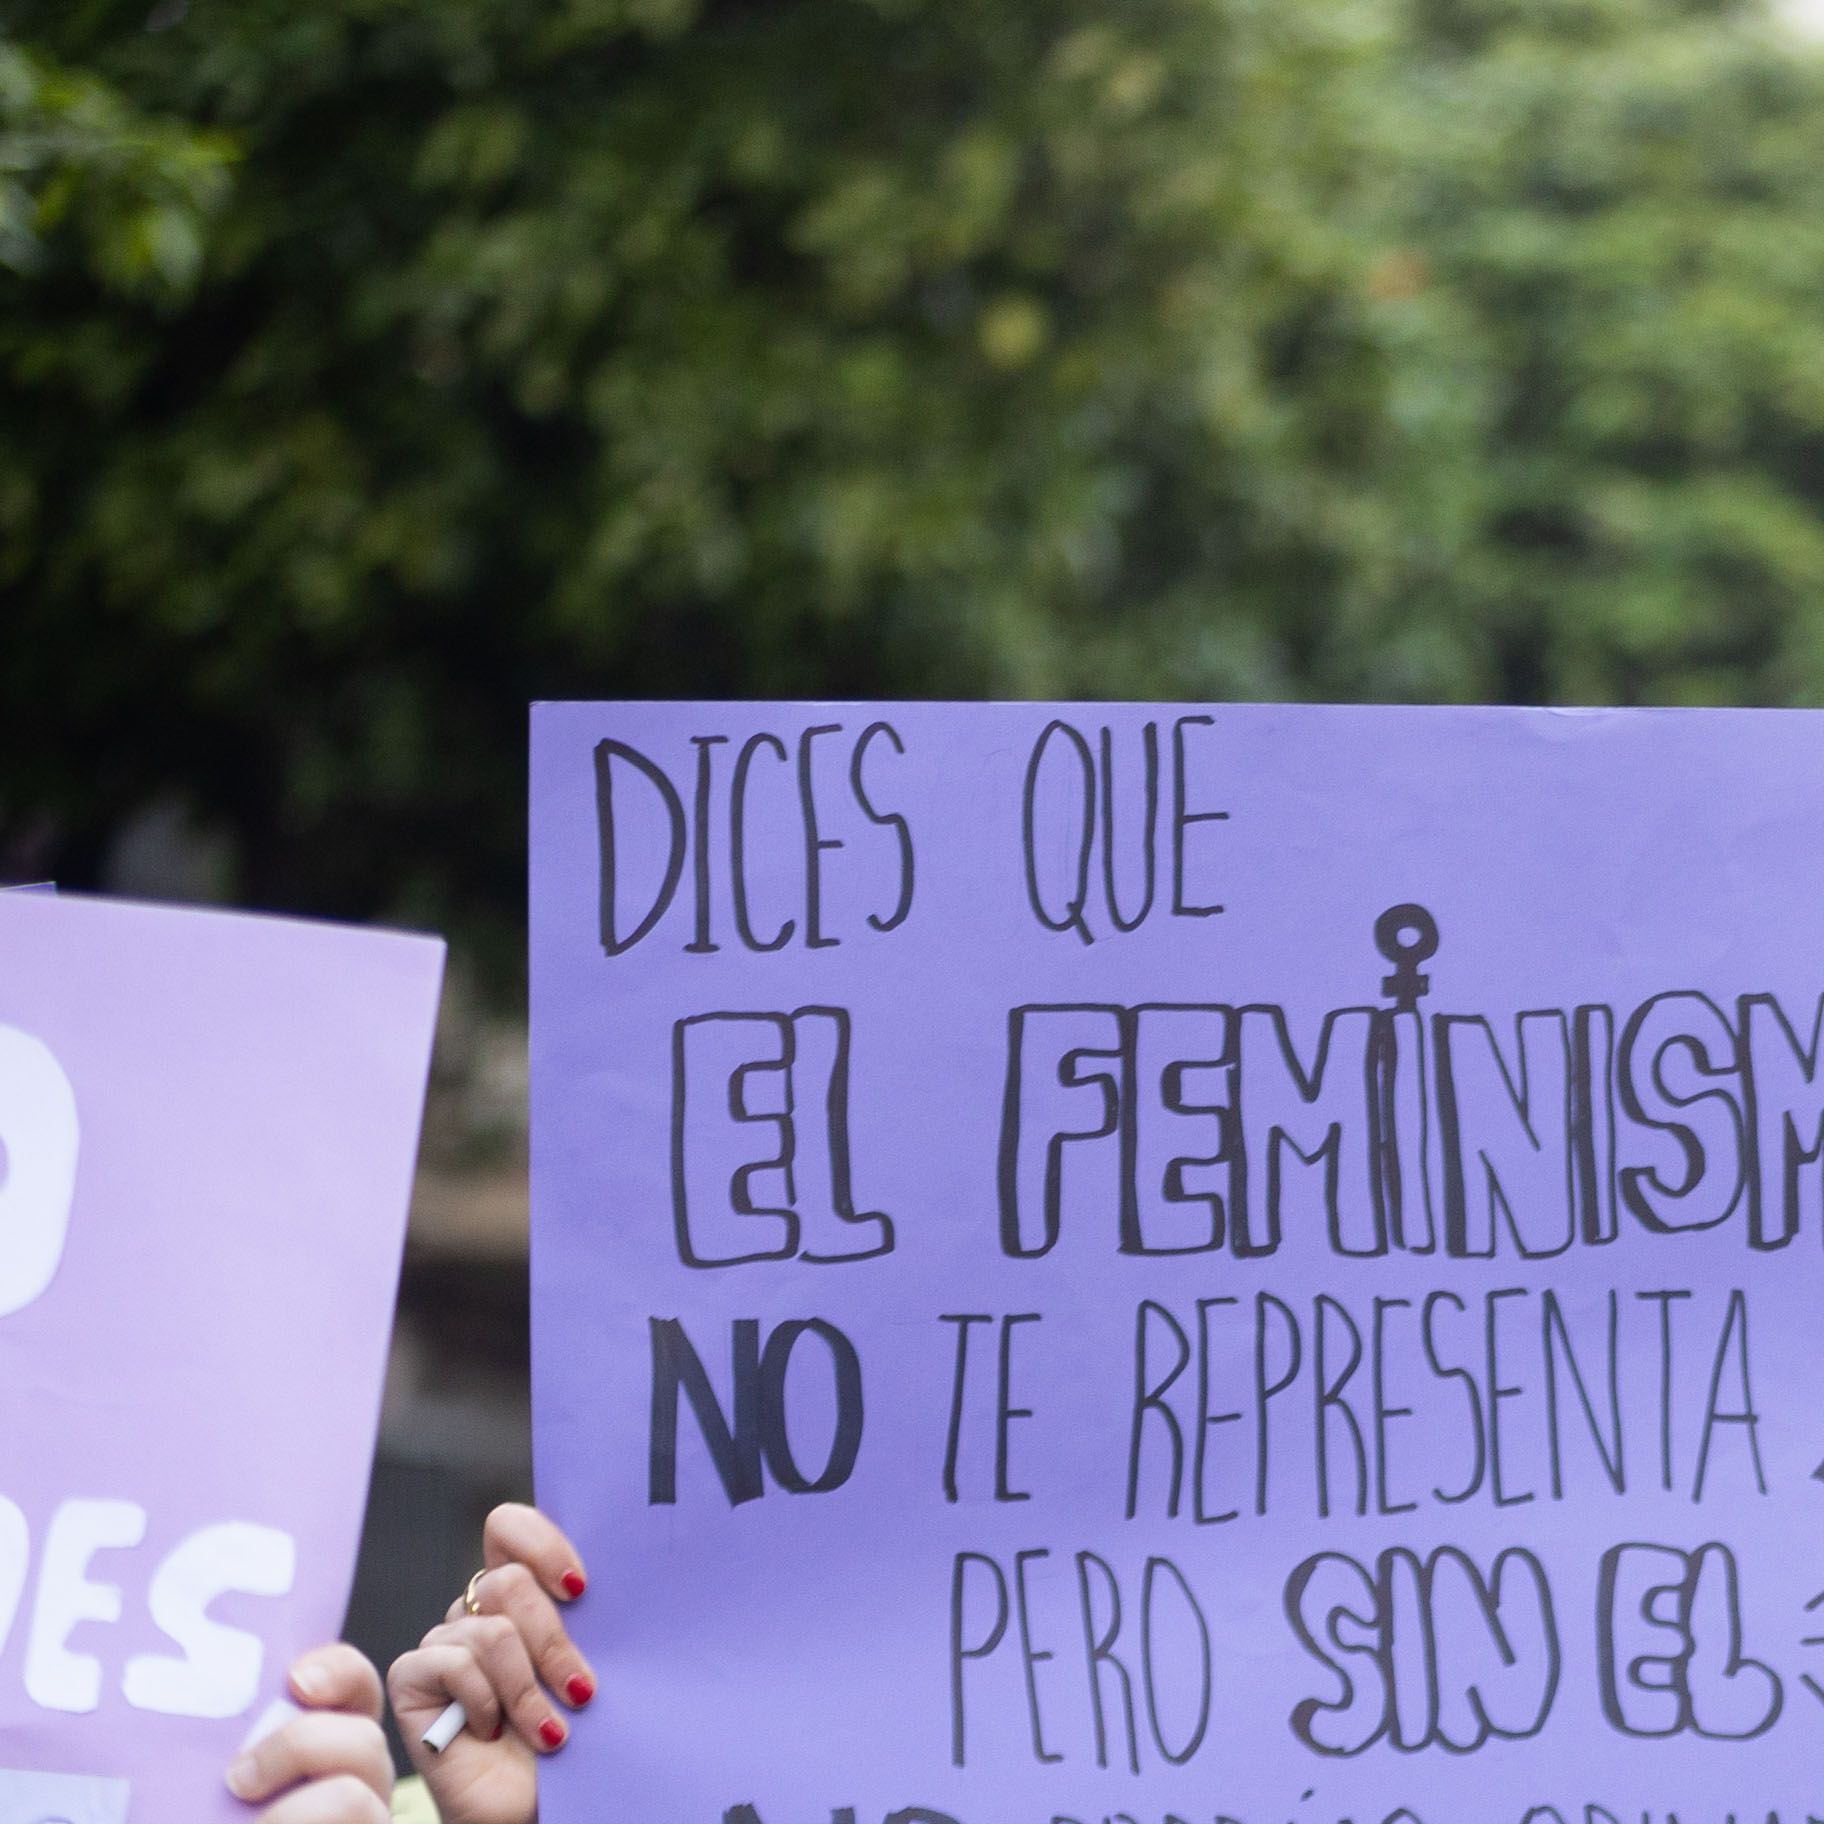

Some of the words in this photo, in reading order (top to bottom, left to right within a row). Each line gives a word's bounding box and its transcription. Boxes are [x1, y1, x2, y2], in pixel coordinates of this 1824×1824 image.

[594, 722, 914, 956] DICES
[1023, 715, 1229, 945] QUE
[671, 1005, 895, 1269] EL
[649, 1316, 864, 1507] NO
[939, 1312, 1043, 1503] TE
[1125, 1286, 1767, 1524] REPRESENTA
[950, 1547, 1213, 1774] PERO
[1283, 1544, 1562, 1758] SIN
[1597, 1541, 1785, 1742] EL
